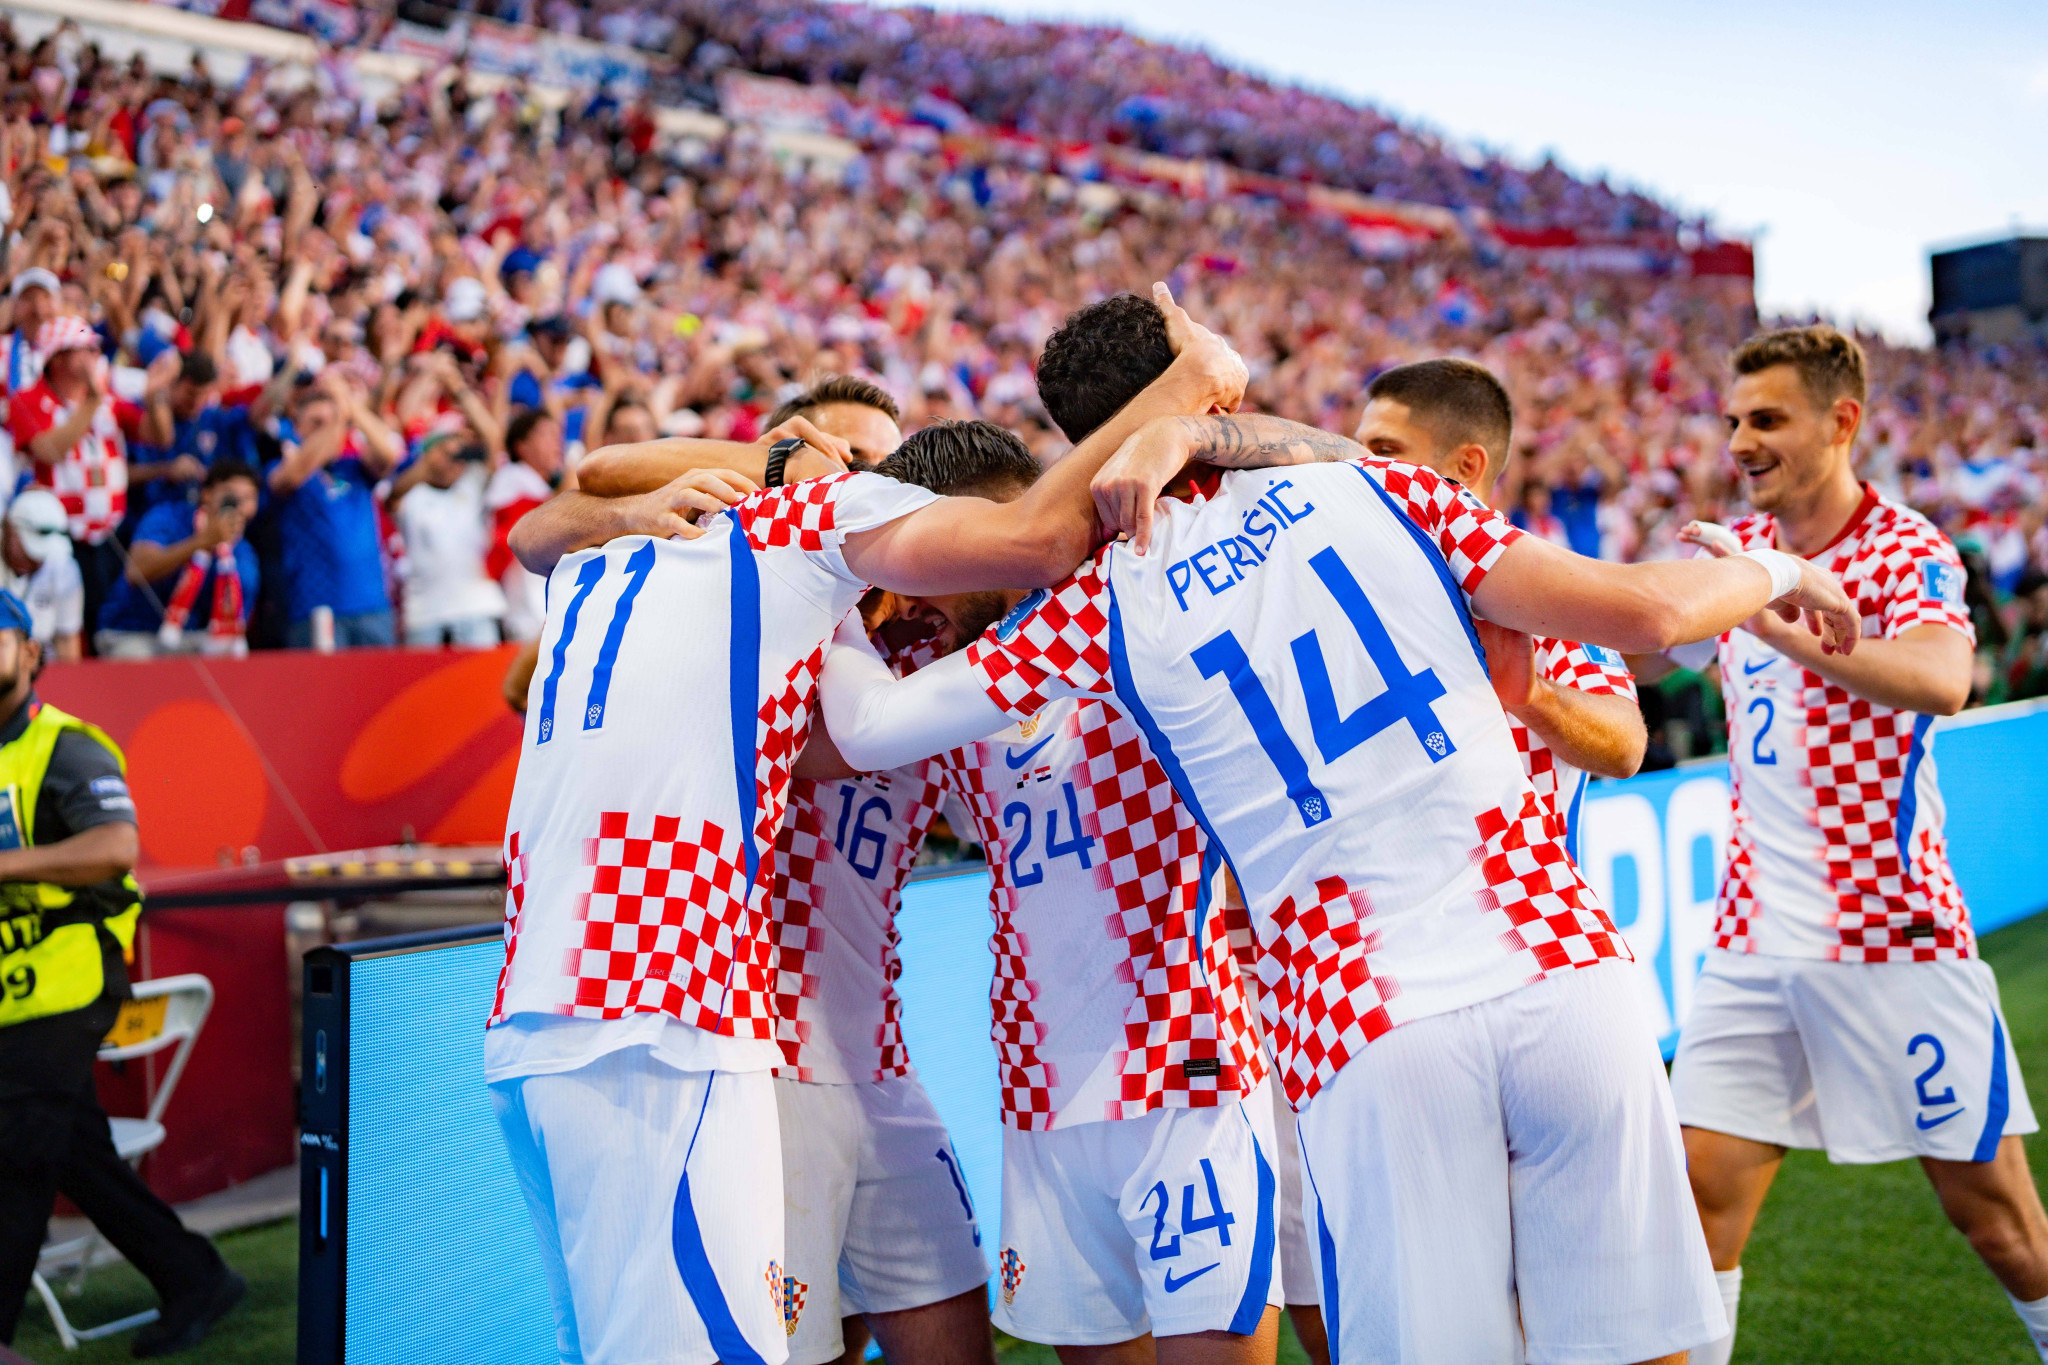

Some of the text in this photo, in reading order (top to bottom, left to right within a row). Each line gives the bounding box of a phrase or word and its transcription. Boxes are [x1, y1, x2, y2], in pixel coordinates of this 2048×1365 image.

[536, 538, 656, 746] 11
[1190, 545, 1458, 829] 14
[1747, 697, 1778, 765] 2
[835, 784, 893, 880] 16
[1003, 782, 1096, 888] 24
[1906, 1033, 1957, 1106] 2
[1138, 1157, 1236, 1261] 24
